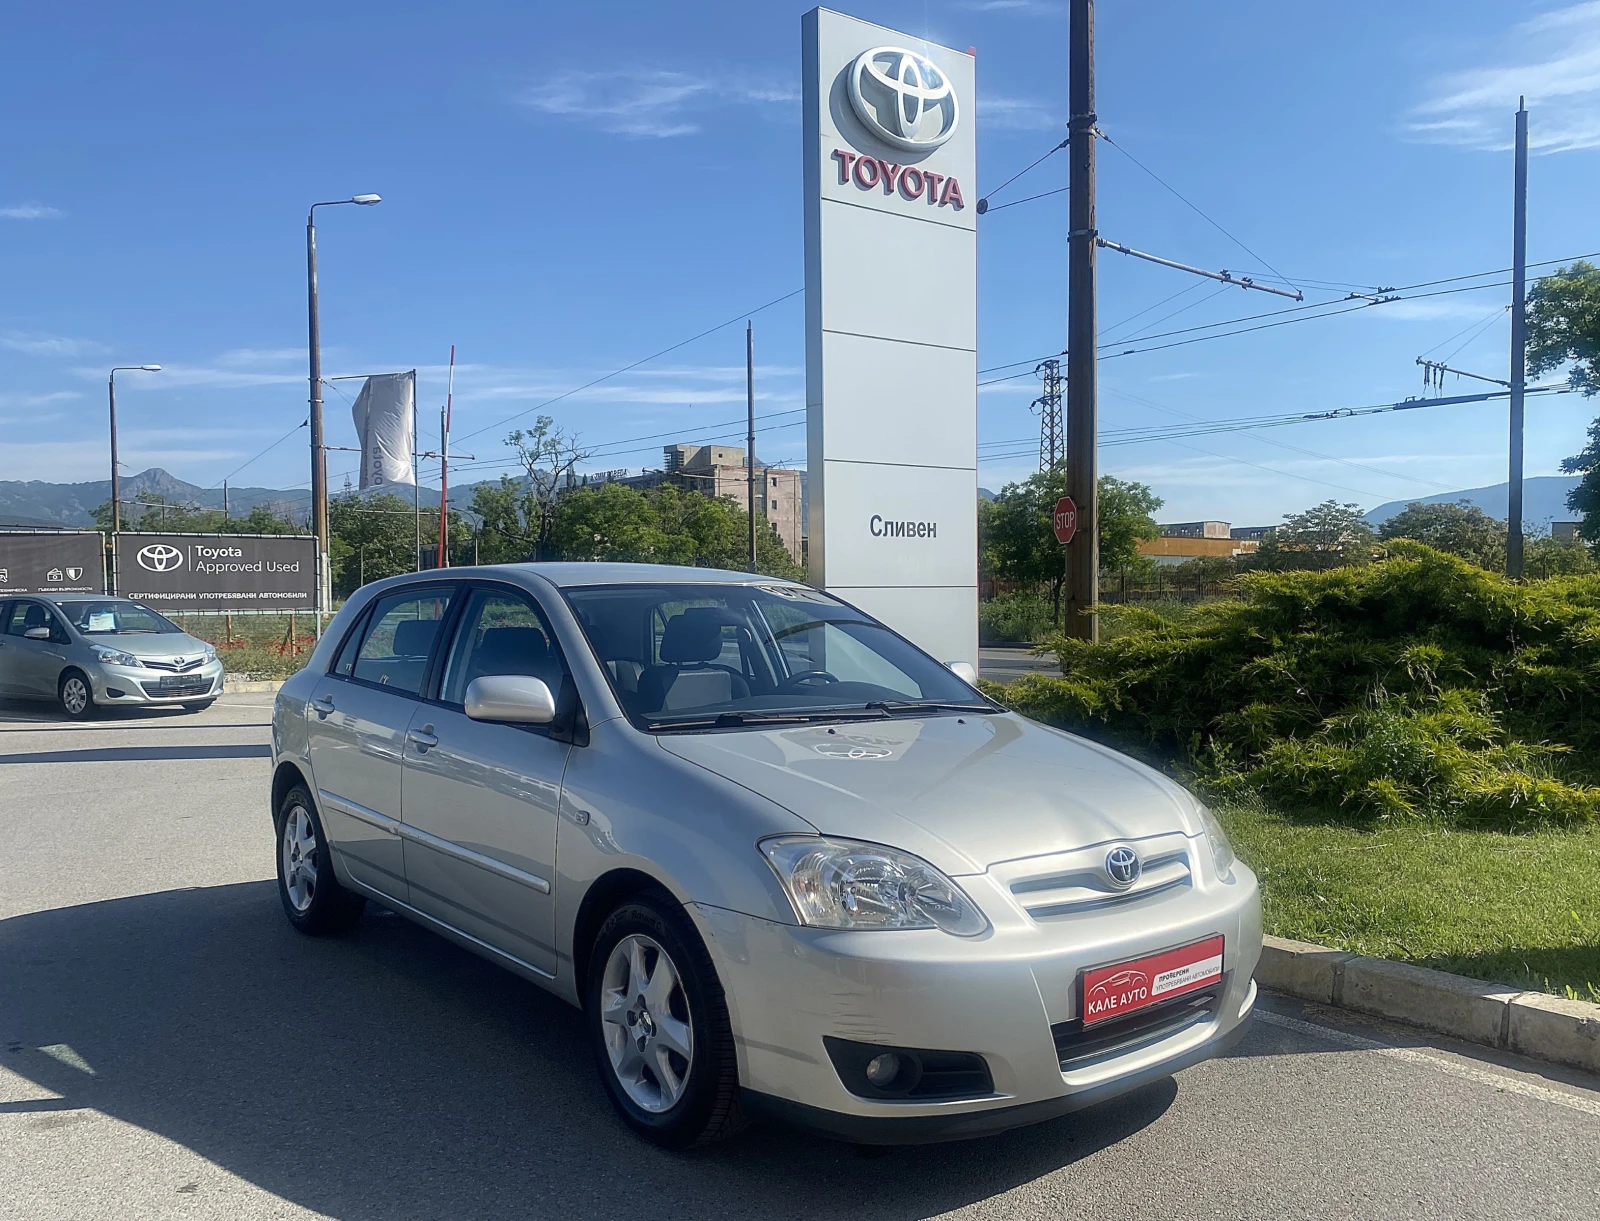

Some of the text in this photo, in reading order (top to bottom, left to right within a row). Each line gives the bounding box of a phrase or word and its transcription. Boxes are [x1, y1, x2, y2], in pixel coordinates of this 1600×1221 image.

[833, 149, 965, 210] TOYOTA
[869, 514, 937, 538] Сливен
[1056, 511, 1075, 530] STOP
[195, 545, 242, 559] Toyota
[195, 561, 299, 574] Approved Used
[128, 592, 197, 600] СЕРТИФИЦИРАНИ
[1158, 967, 1190, 982] ПРОВЕРЕНИ
[1192, 966, 1220, 980] АВТОМОБИЛИ
[1088, 986, 1148, 1015] КАЛЕ АУТО
